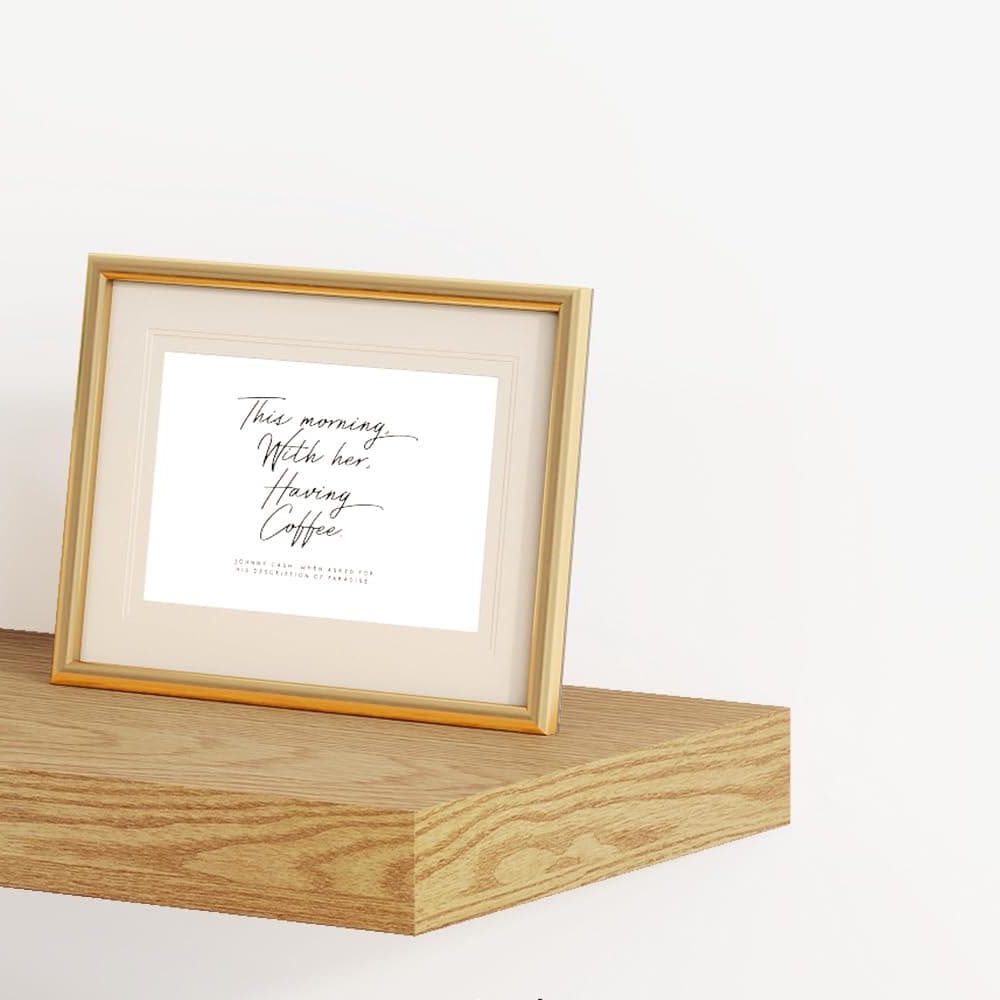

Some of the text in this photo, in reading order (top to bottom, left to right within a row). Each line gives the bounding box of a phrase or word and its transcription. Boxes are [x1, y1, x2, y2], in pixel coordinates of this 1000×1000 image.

[237, 396, 292, 430] This
[257, 428, 324, 472] With
[261, 468, 384, 519] Having
[253, 567, 309, 579] DESCRIPTION
[300, 564, 323, 572] WHEN
[328, 567, 354, 575] ASKED
[358, 569, 374, 577] FOR
